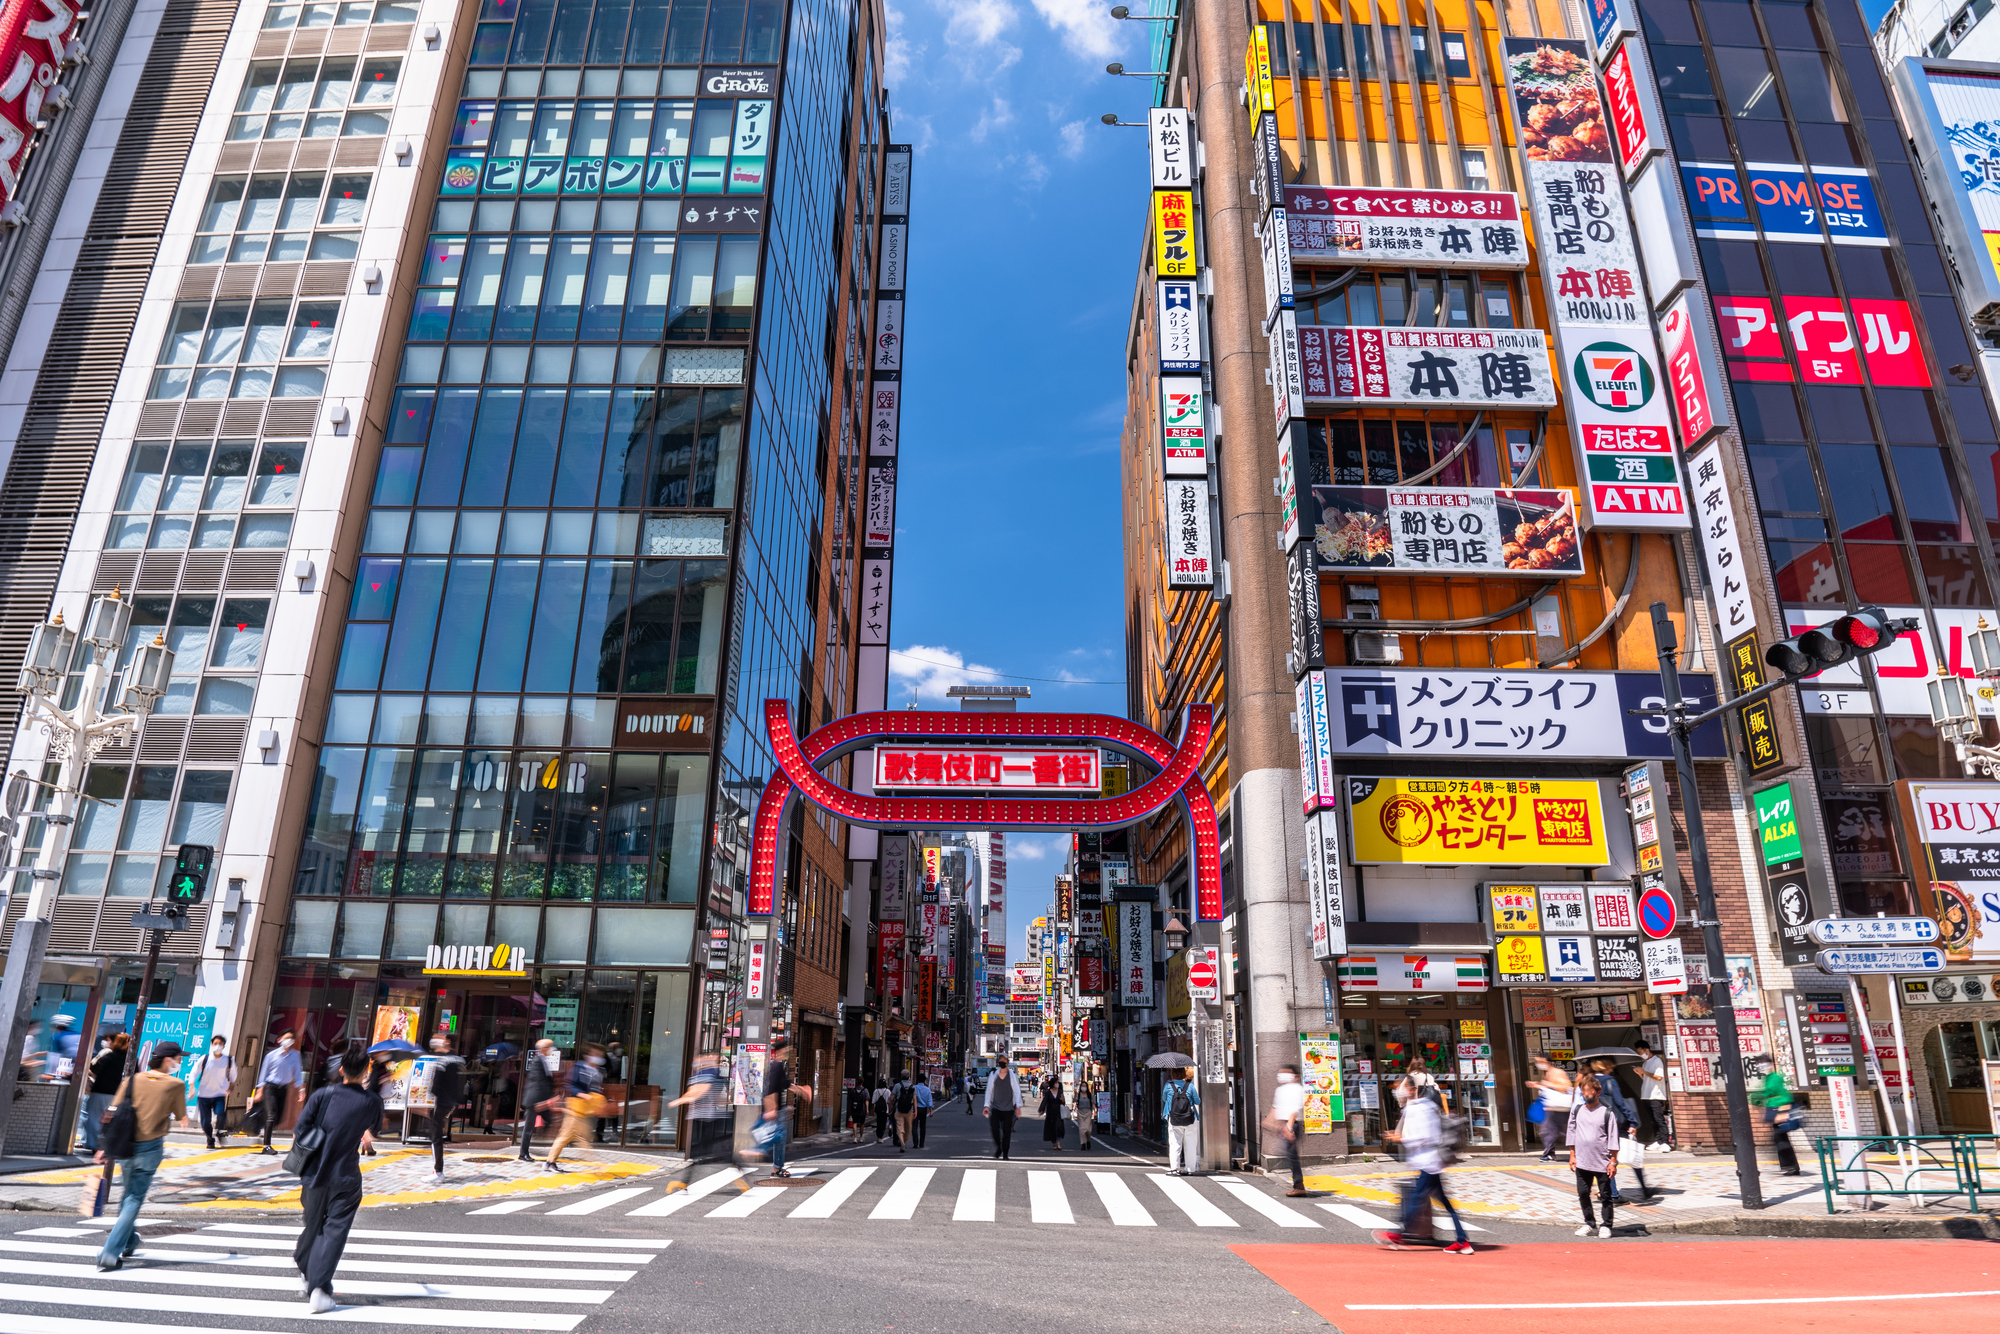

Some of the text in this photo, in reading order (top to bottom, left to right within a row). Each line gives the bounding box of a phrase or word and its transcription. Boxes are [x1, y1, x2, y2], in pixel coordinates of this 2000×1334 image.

[1595, 11, 1618, 51] プロミス 6F
[1258, 45, 1269, 80] 麻雀ブル
[706, 76, 769, 93] GROVE
[1261, 82, 1271, 90] 6F
[741, 103, 766, 151] ダーツ
[1611, 77, 1644, 168] アイフル 5F
[899, 145, 909, 153] 10
[1160, 112, 1182, 181] 小松ビル
[1265, 115, 1278, 163] BUZZ STAND
[484, 160, 722, 192] ビアポンバー
[889, 175, 900, 206] ABYSS
[705, 206, 760, 223] すずや
[1294, 195, 1502, 215] 作って食べて楽しめる!!
[1574, 169, 1615, 244] 粉もの
[1161, 193, 1189, 261] 麻雀ブル
[1543, 179, 1586, 255] 専門店
[1800, 208, 1869, 228] プロミス
[1289, 220, 1361, 236] 歌舞伎町
[1368, 225, 1435, 239] お好み焼き
[1289, 235, 1326, 250] 名物
[1369, 237, 1424, 250] 鉄板焼き
[1439, 224, 1519, 255] 本陣
[887, 228, 899, 287] CASINO POKER
[1167, 262, 1186, 273] 6F
[1277, 220, 1291, 295] メンズライフクリニック
[1556, 266, 1636, 300] 本陣
[895, 292, 901, 300] 8
[1281, 296, 1293, 304] 3F
[1567, 300, 1636, 320] HONJIN
[1168, 311, 1179, 352] クリニック
[1180, 311, 1191, 359] メンズライフ
[1390, 332, 1539, 348] 歌舞伎町名物 HONJIN
[1720, 306, 1911, 355] アイフル
[1286, 329, 1300, 396] 歌舞伎町名物
[1304, 331, 1325, 393] お好み焼
[1333, 331, 1354, 393] たこ焼き
[1361, 332, 1384, 395] もんじゃ焼き
[1811, 359, 1844, 378] 5F
[1406, 351, 1536, 399] 本陣
[1675, 353, 1705, 437] アコム 3F
[876, 419, 894, 447] 魚金
[1171, 429, 1198, 437] たばこ
[1593, 426, 1661, 451] たばこ
[887, 459, 893, 467] 6
[1174, 449, 1197, 457] ATM
[1615, 457, 1647, 481] 酒
[1391, 493, 1469, 506] 歌舞伎町名物
[1602, 488, 1678, 512] ATM
[1180, 485, 1198, 555] お好み焼き
[1401, 511, 1483, 536] 粉もの
[1404, 538, 1488, 564] 専門店
[1697, 457, 1745, 626] 東京ぐらんど
[882, 551, 889, 559] 5
[1174, 557, 1208, 573] 本陣
[1176, 573, 1206, 583] HONJIN
[866, 581, 883, 639] すずや
[1736, 644, 1760, 696] 買取
[1406, 676, 1597, 710] メンズライフ
[1819, 693, 1849, 711] 3F
[625, 713, 705, 734] DOUTOR
[1313, 684, 1329, 758] ファイトフィット
[1409, 716, 1567, 750] クリニック
[1749, 710, 1773, 760] 販売
[884, 752, 1091, 784] 歌舞伎町一番街
[1352, 781, 1373, 797] 2F
[1409, 782, 1446, 792] 営業時間
[1431, 794, 1518, 822] やきとり
[1537, 801, 1585, 820] やきとり
[1760, 799, 1790, 824] レイク
[1925, 802, 2000, 831] BUY
[1436, 823, 1527, 851] センター
[1540, 819, 1585, 838] 専門店
[1764, 820, 1797, 844] ALSA
[1642, 847, 1658, 861] 麻雀
[1647, 858, 1660, 869] ブル
[1781, 862, 1790, 871] B1
[884, 859, 898, 904] バンタイ
[1325, 837, 1342, 928] 歌舞伎町名物
[922, 894, 938, 902] B1F
[1504, 894, 1523, 907] 麻雀
[1503, 910, 1528, 923] ブル
[1546, 903, 1583, 919] 本陣
[1596, 896, 1607, 926] お好み焼
[1607, 896, 1618, 926] たこ焼き
[1618, 896, 1630, 926] もんじゃ焼き
[882, 923, 904, 934] 焼肉
[1496, 922, 1538, 930] 新宿店 6F
[1555, 919, 1575, 928] HONJIN
[1841, 922, 1912, 933] 大久保病院
[1129, 904, 1144, 995] お好み焼き 本陣
[1597, 938, 1626, 950] BUZZ
[425, 943, 526, 972] DOUTOR
[1507, 954, 1532, 962] やきとり
[1598, 949, 1637, 961] STAND
[1599, 961, 1623, 969] DARTS
[1647, 955, 1682, 968] タクシーの客待ち
[1798, 954, 1808, 962] B2
[1844, 952, 1921, 963] 東京都健康プラザハイジア
[750, 944, 763, 995] 劇場通り
[1509, 962, 1534, 971] センター
[1601, 969, 1636, 979] KARAOKE
[1648, 967, 1666, 977] を除く
[1501, 974, 1544, 983] 朝まで営業中
[1908, 982, 1926, 992] 買取
[1125, 996, 1150, 1005] HONJIN
[1909, 993, 1929, 1001] BUY
[144, 1021, 184, 1034] ILUMA
[1458, 1044, 1478, 1055] たばこ
[1551, 1050, 1573, 1059] 麻雀ブル
